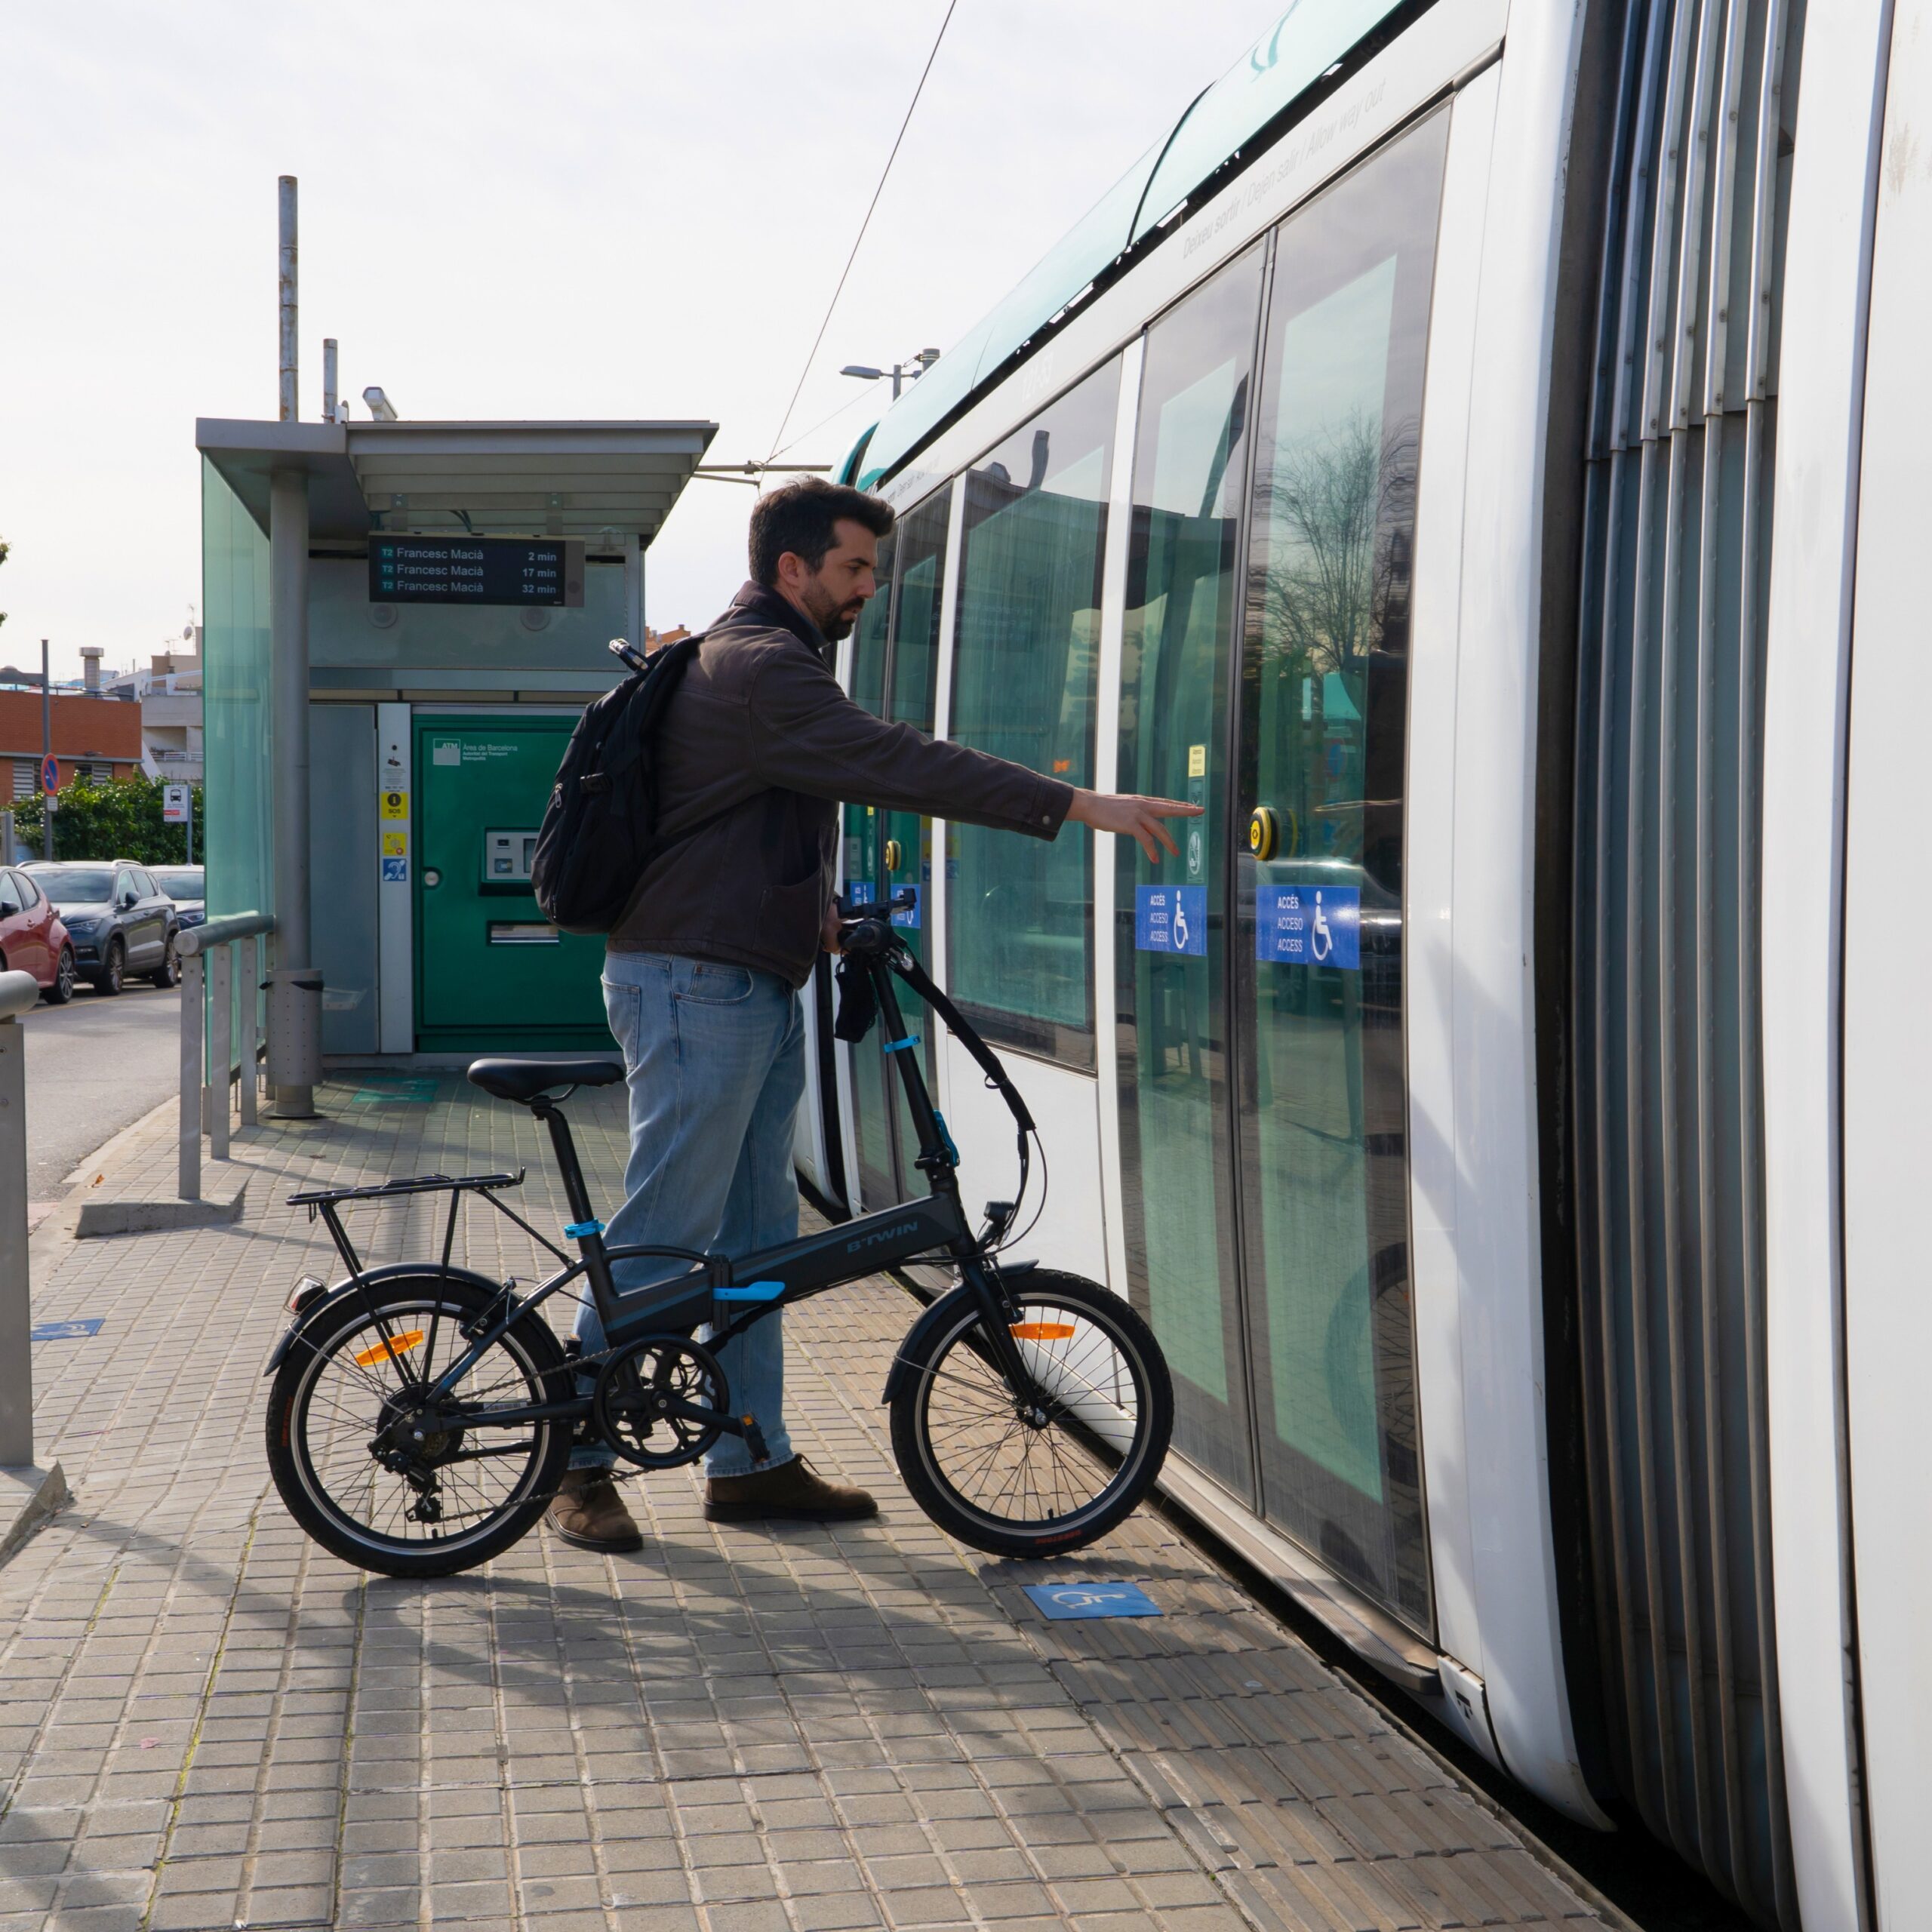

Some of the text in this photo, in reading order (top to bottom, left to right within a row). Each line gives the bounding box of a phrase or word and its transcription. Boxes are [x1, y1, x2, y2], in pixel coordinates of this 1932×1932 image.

[1183, 226, 1213, 260] Deixeu
[1214, 198, 1240, 231] sortir
[1247, 173, 1275, 210] Dejen
[1276, 150, 1300, 183] salir
[1306, 120, 1337, 158] Allow
[1340, 101, 1363, 134] way
[1365, 78, 1386, 112] out
[397, 548, 447, 559] Francesc
[451, 549, 484, 560] Macià
[528, 552, 535, 561] 2
[537, 552, 557, 561] min
[397, 565, 447, 575] Francesc
[451, 565, 484, 577] Macià
[522, 568, 534, 577] 17
[537, 568, 557, 577] min
[382, 580, 556, 594] T2 Francesc Macià 32 min
[1150, 894, 1165, 906] ACCÉS
[1278, 893, 1299, 909] ACCÉS
[1150, 913, 1168, 924] ACCESO
[1278, 917, 1303, 931] ACCESO
[1150, 931, 1168, 943] ACCESS
[1278, 938, 1303, 952] ACCESS
